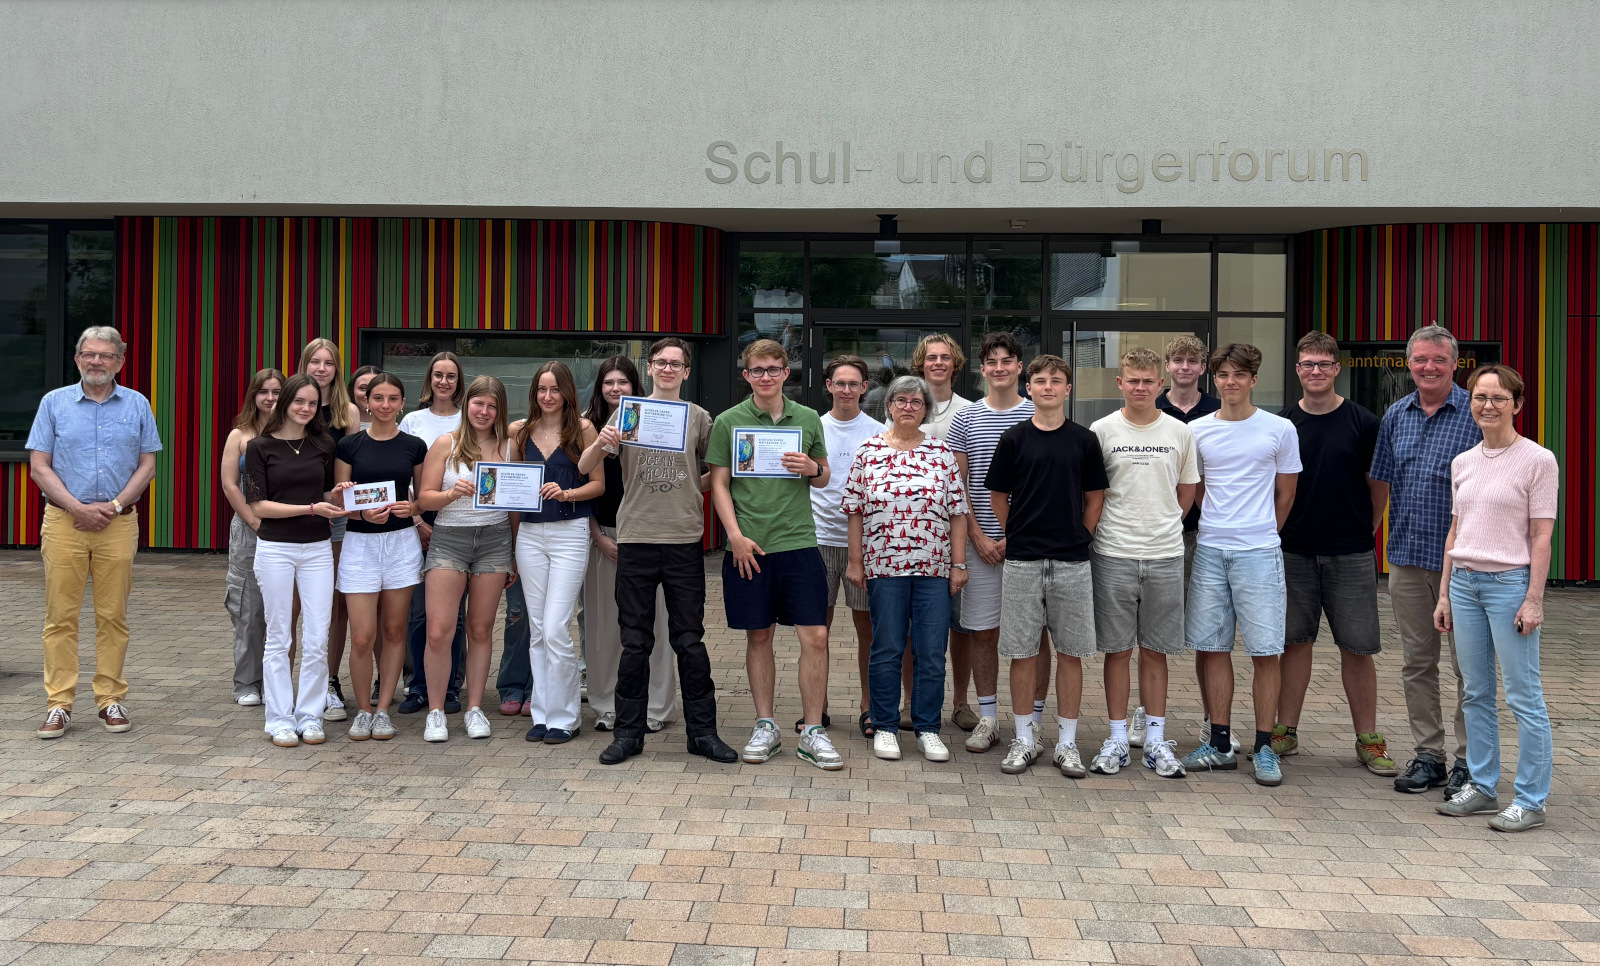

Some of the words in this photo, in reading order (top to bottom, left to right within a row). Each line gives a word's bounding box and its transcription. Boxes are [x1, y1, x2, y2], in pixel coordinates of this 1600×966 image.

[704, 140, 873, 185] Schul-
[896, 140, 993, 184] und
[1018, 138, 1370, 194] Bürgerforum
